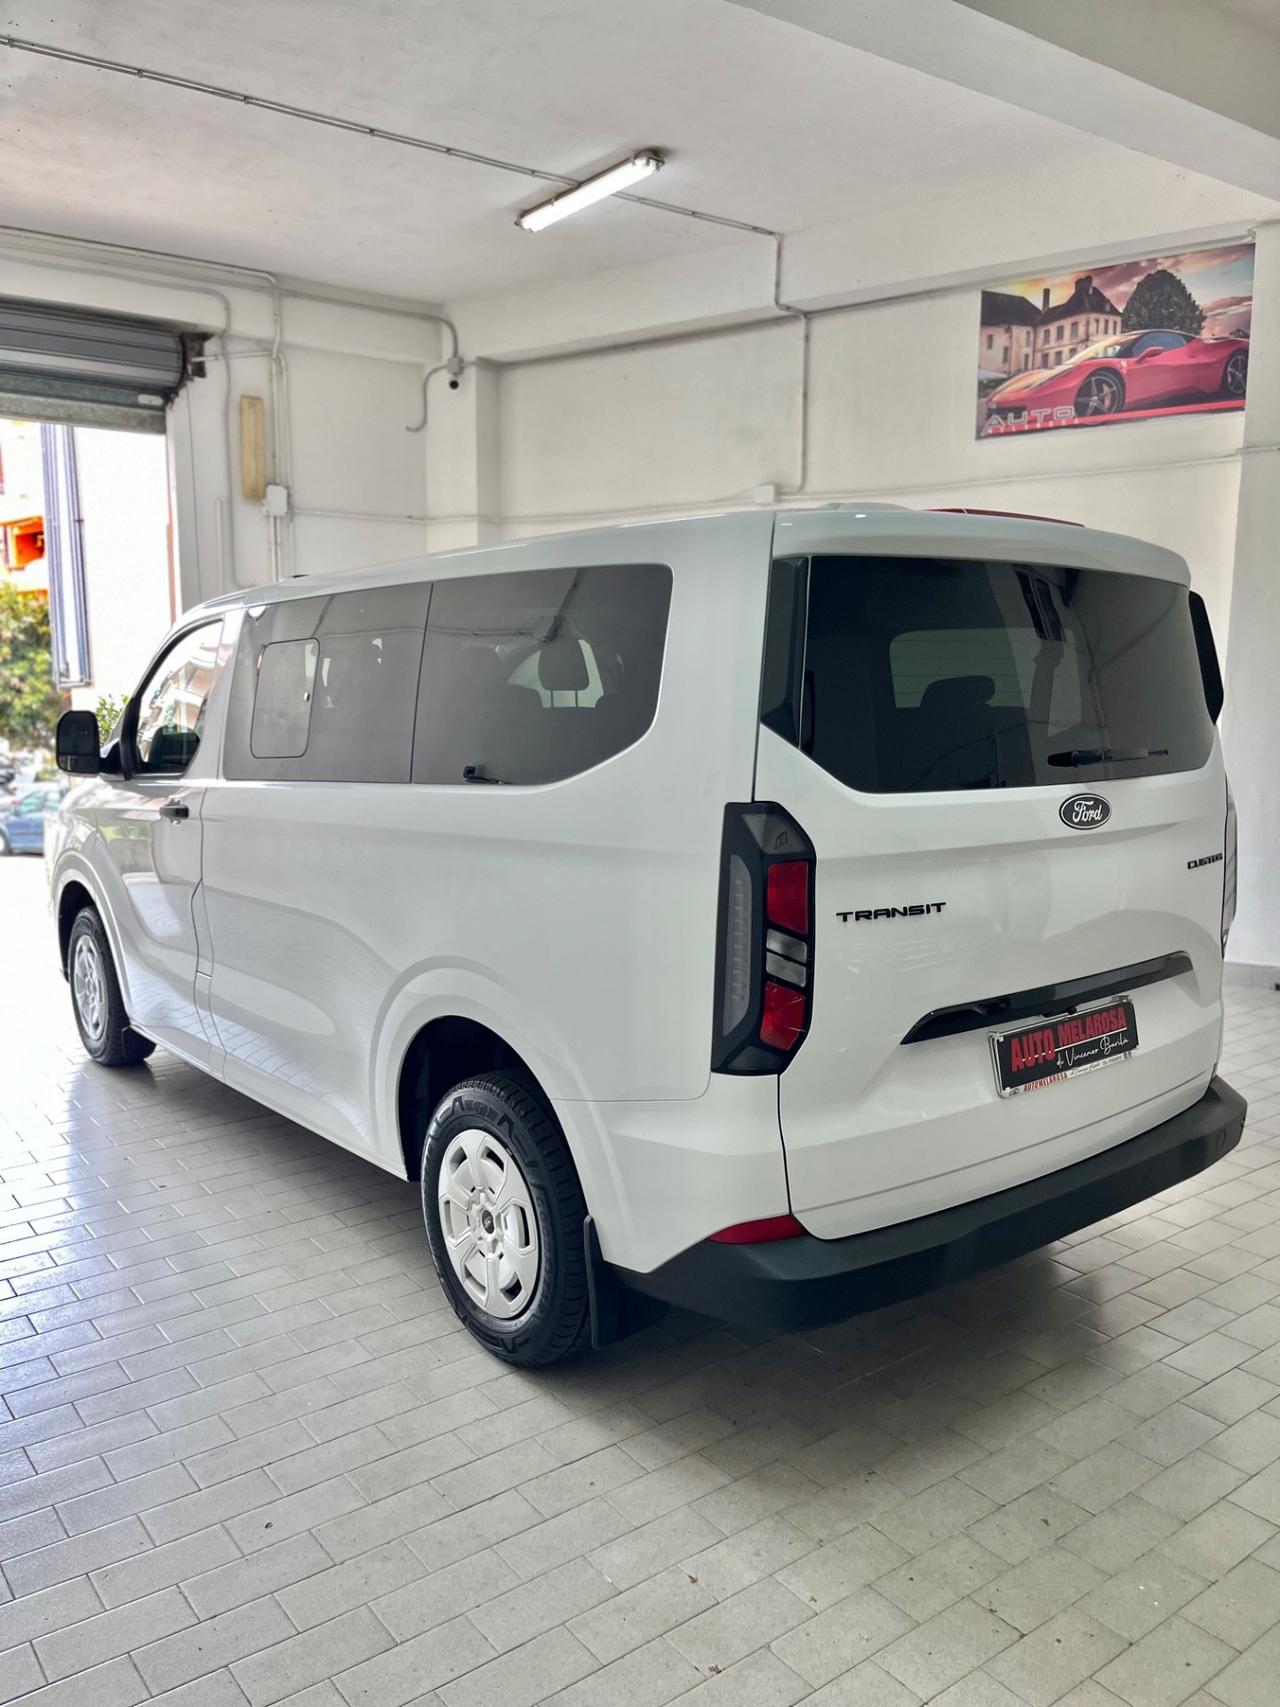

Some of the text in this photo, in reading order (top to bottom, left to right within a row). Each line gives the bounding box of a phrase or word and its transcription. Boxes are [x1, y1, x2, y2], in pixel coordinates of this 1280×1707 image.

[980, 405, 1077, 436] AUTO
[1072, 800, 1103, 823] Ford
[836, 902, 946, 922] TRANSIT
[1011, 1029, 1056, 1072] AUTO
[1058, 1007, 1126, 1046] MELAROSA
